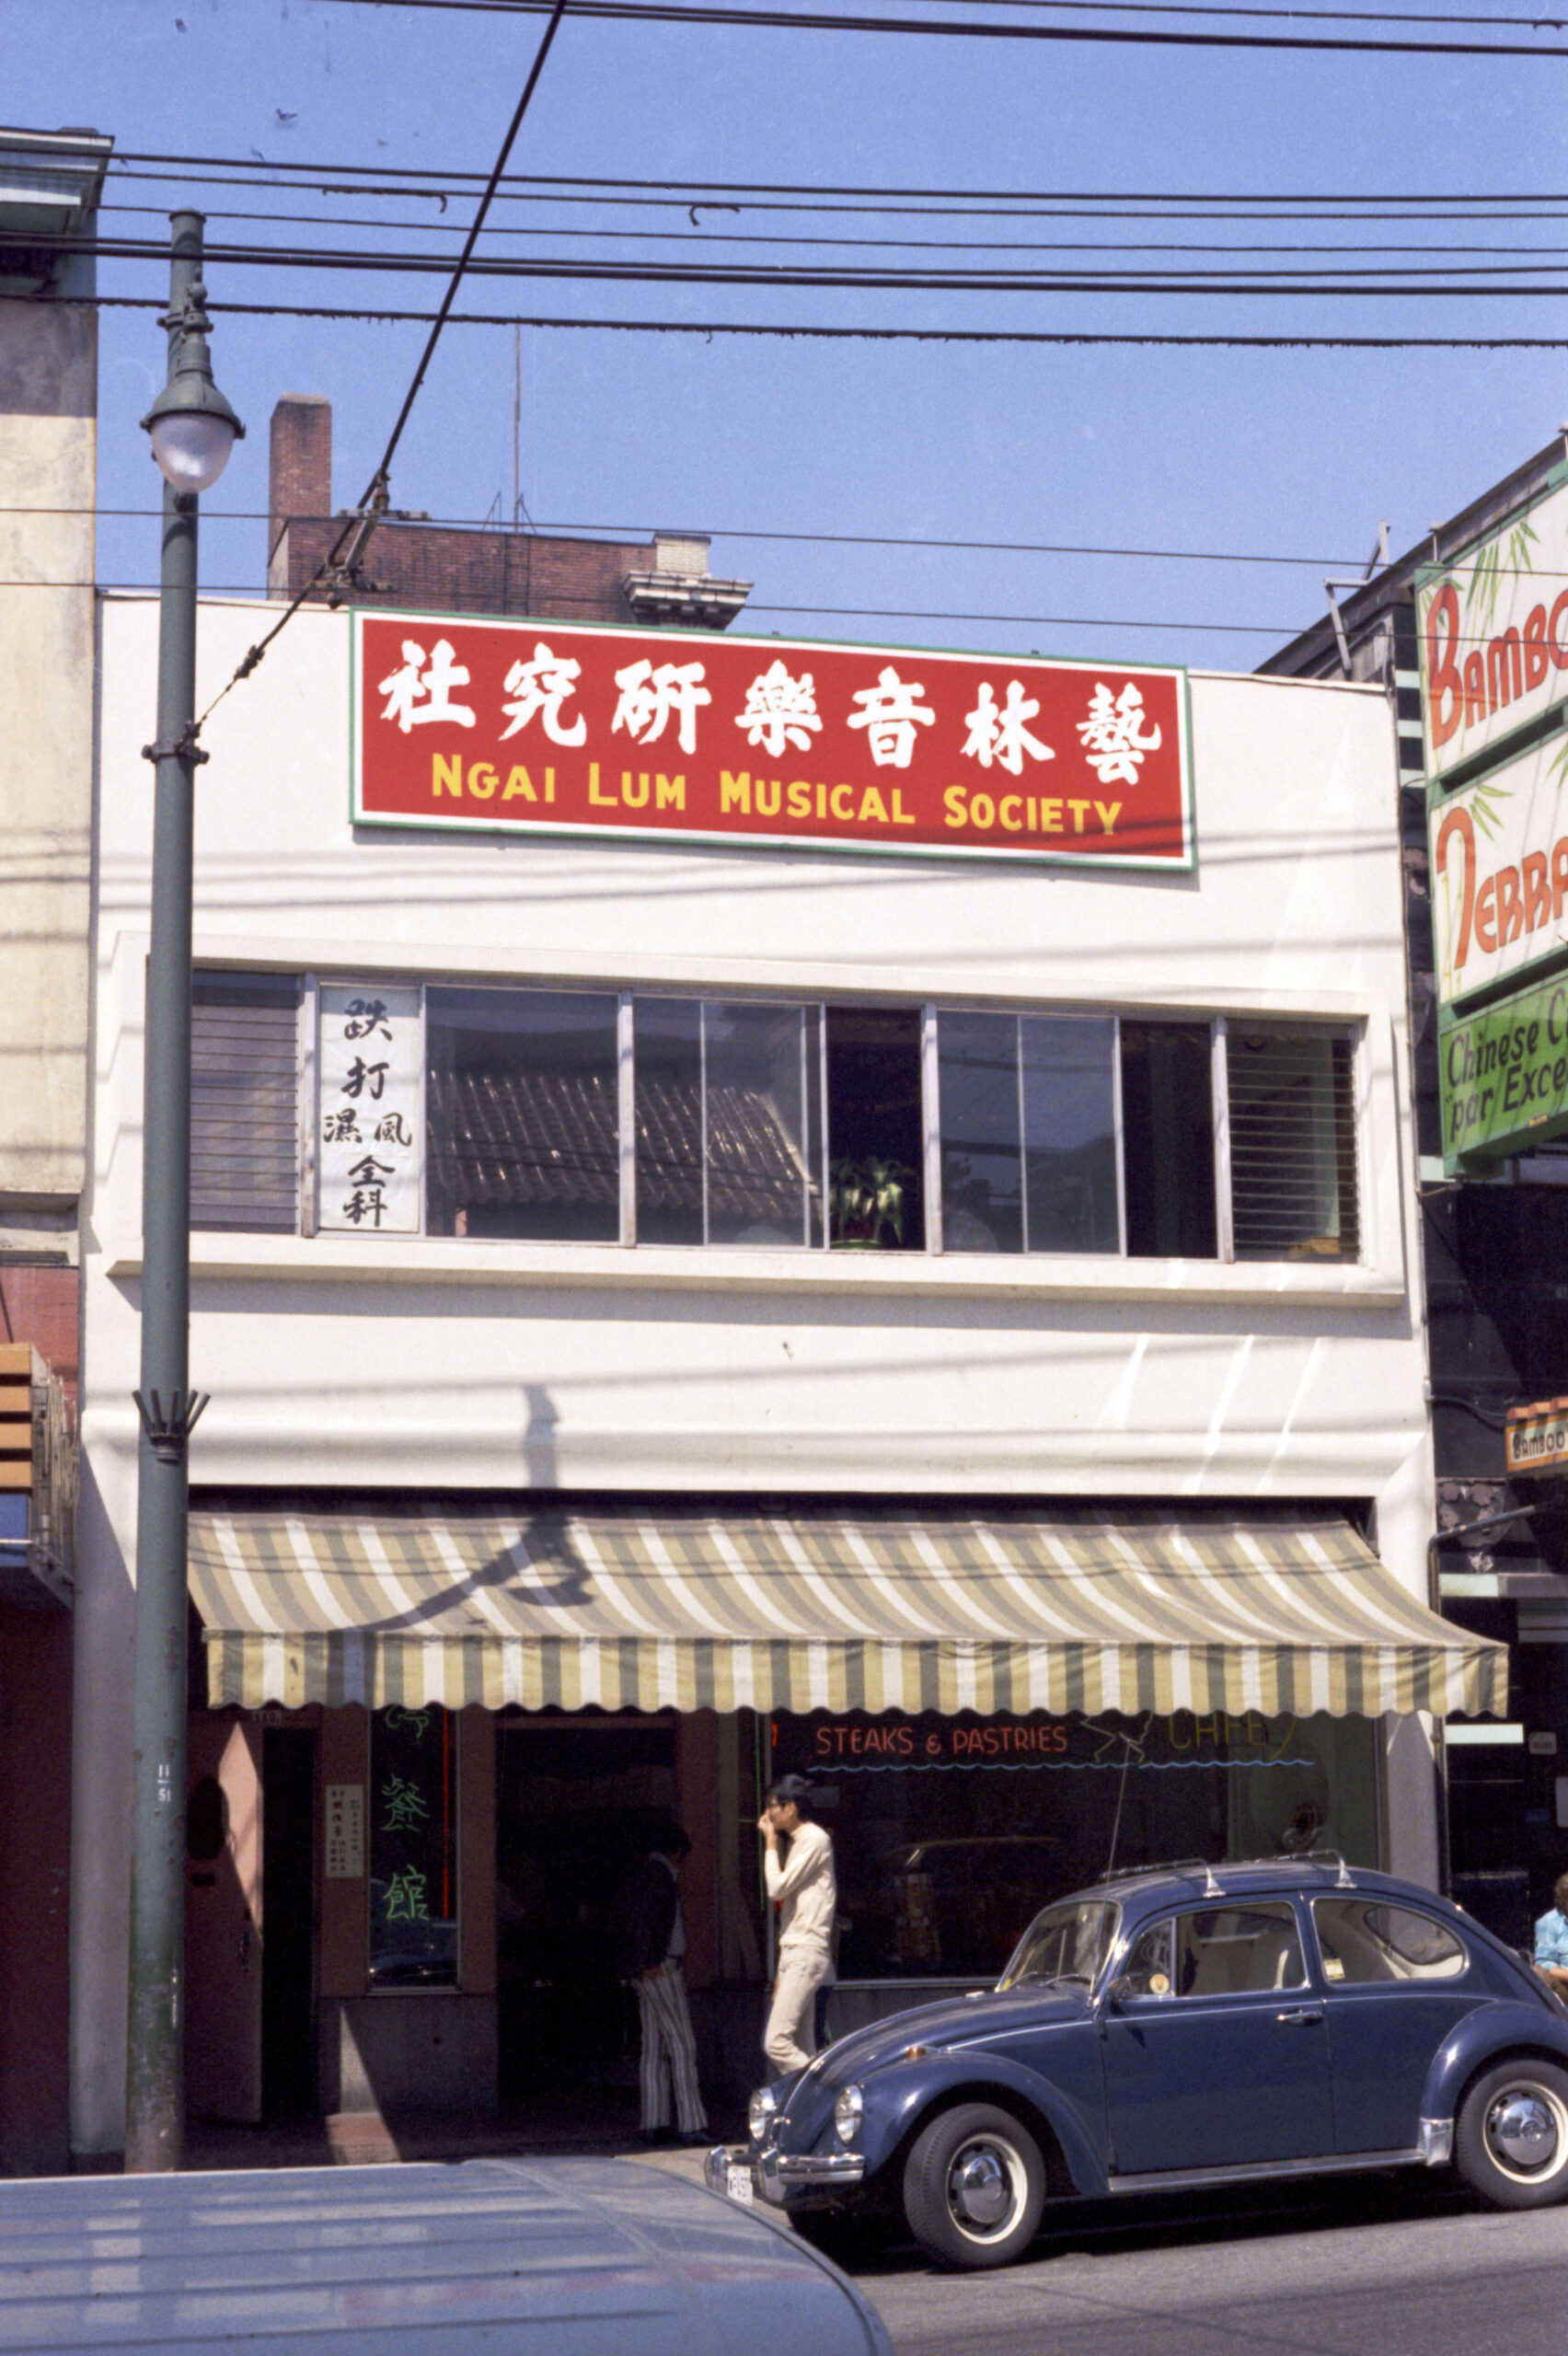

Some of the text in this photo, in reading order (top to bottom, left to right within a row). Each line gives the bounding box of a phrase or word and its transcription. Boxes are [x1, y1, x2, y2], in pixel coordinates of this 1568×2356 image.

[432, 753, 1123, 836] NGAI LUM MUSICAL SOCIETY
[1447, 1021, 1540, 1089] Chinese
[1513, 1430, 1565, 1460] BAMBOO
[815, 1725, 1069, 1756] STEAKS & PASTRIES
